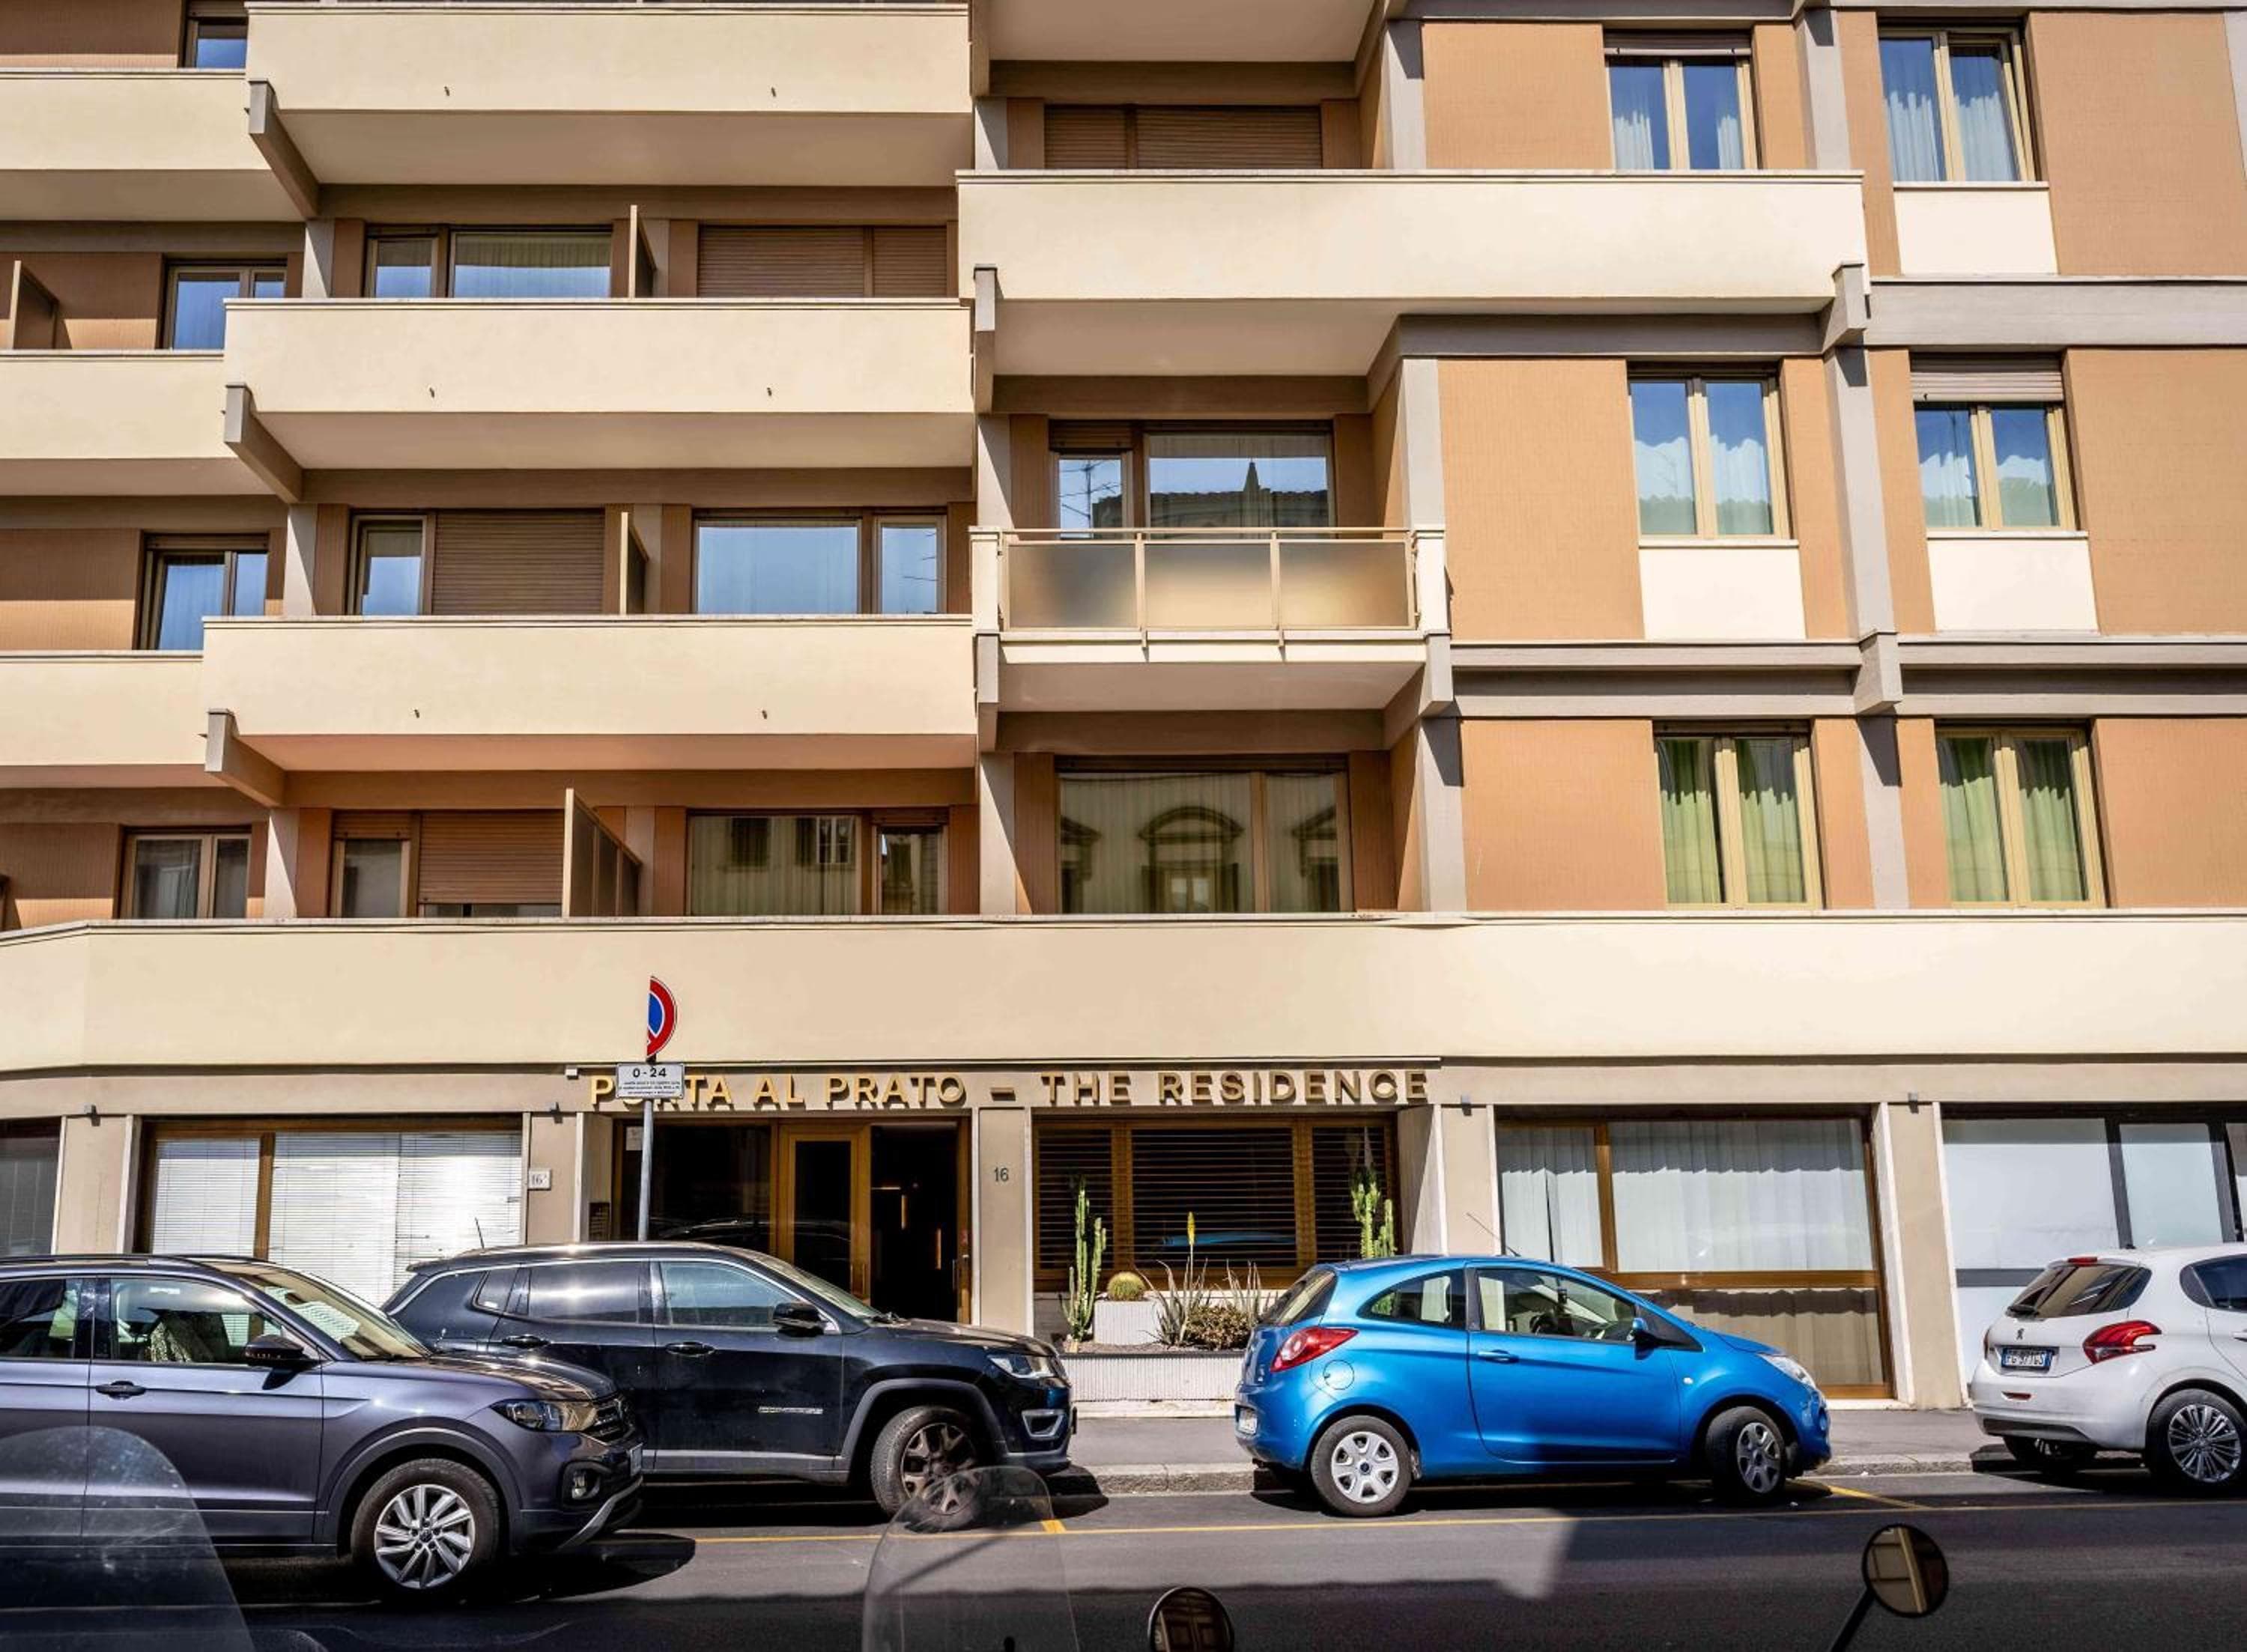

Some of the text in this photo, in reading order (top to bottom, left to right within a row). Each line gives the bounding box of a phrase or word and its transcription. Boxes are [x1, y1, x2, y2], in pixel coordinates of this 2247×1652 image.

[590, 1075, 733, 1105] PTA
[755, 1074, 804, 1104] AL
[825, 1072, 965, 1104] PRATO
[1041, 1072, 1129, 1103] THE
[1158, 1069, 1428, 1103] RESIDENCE
[994, 1167, 1009, 1182] 16
